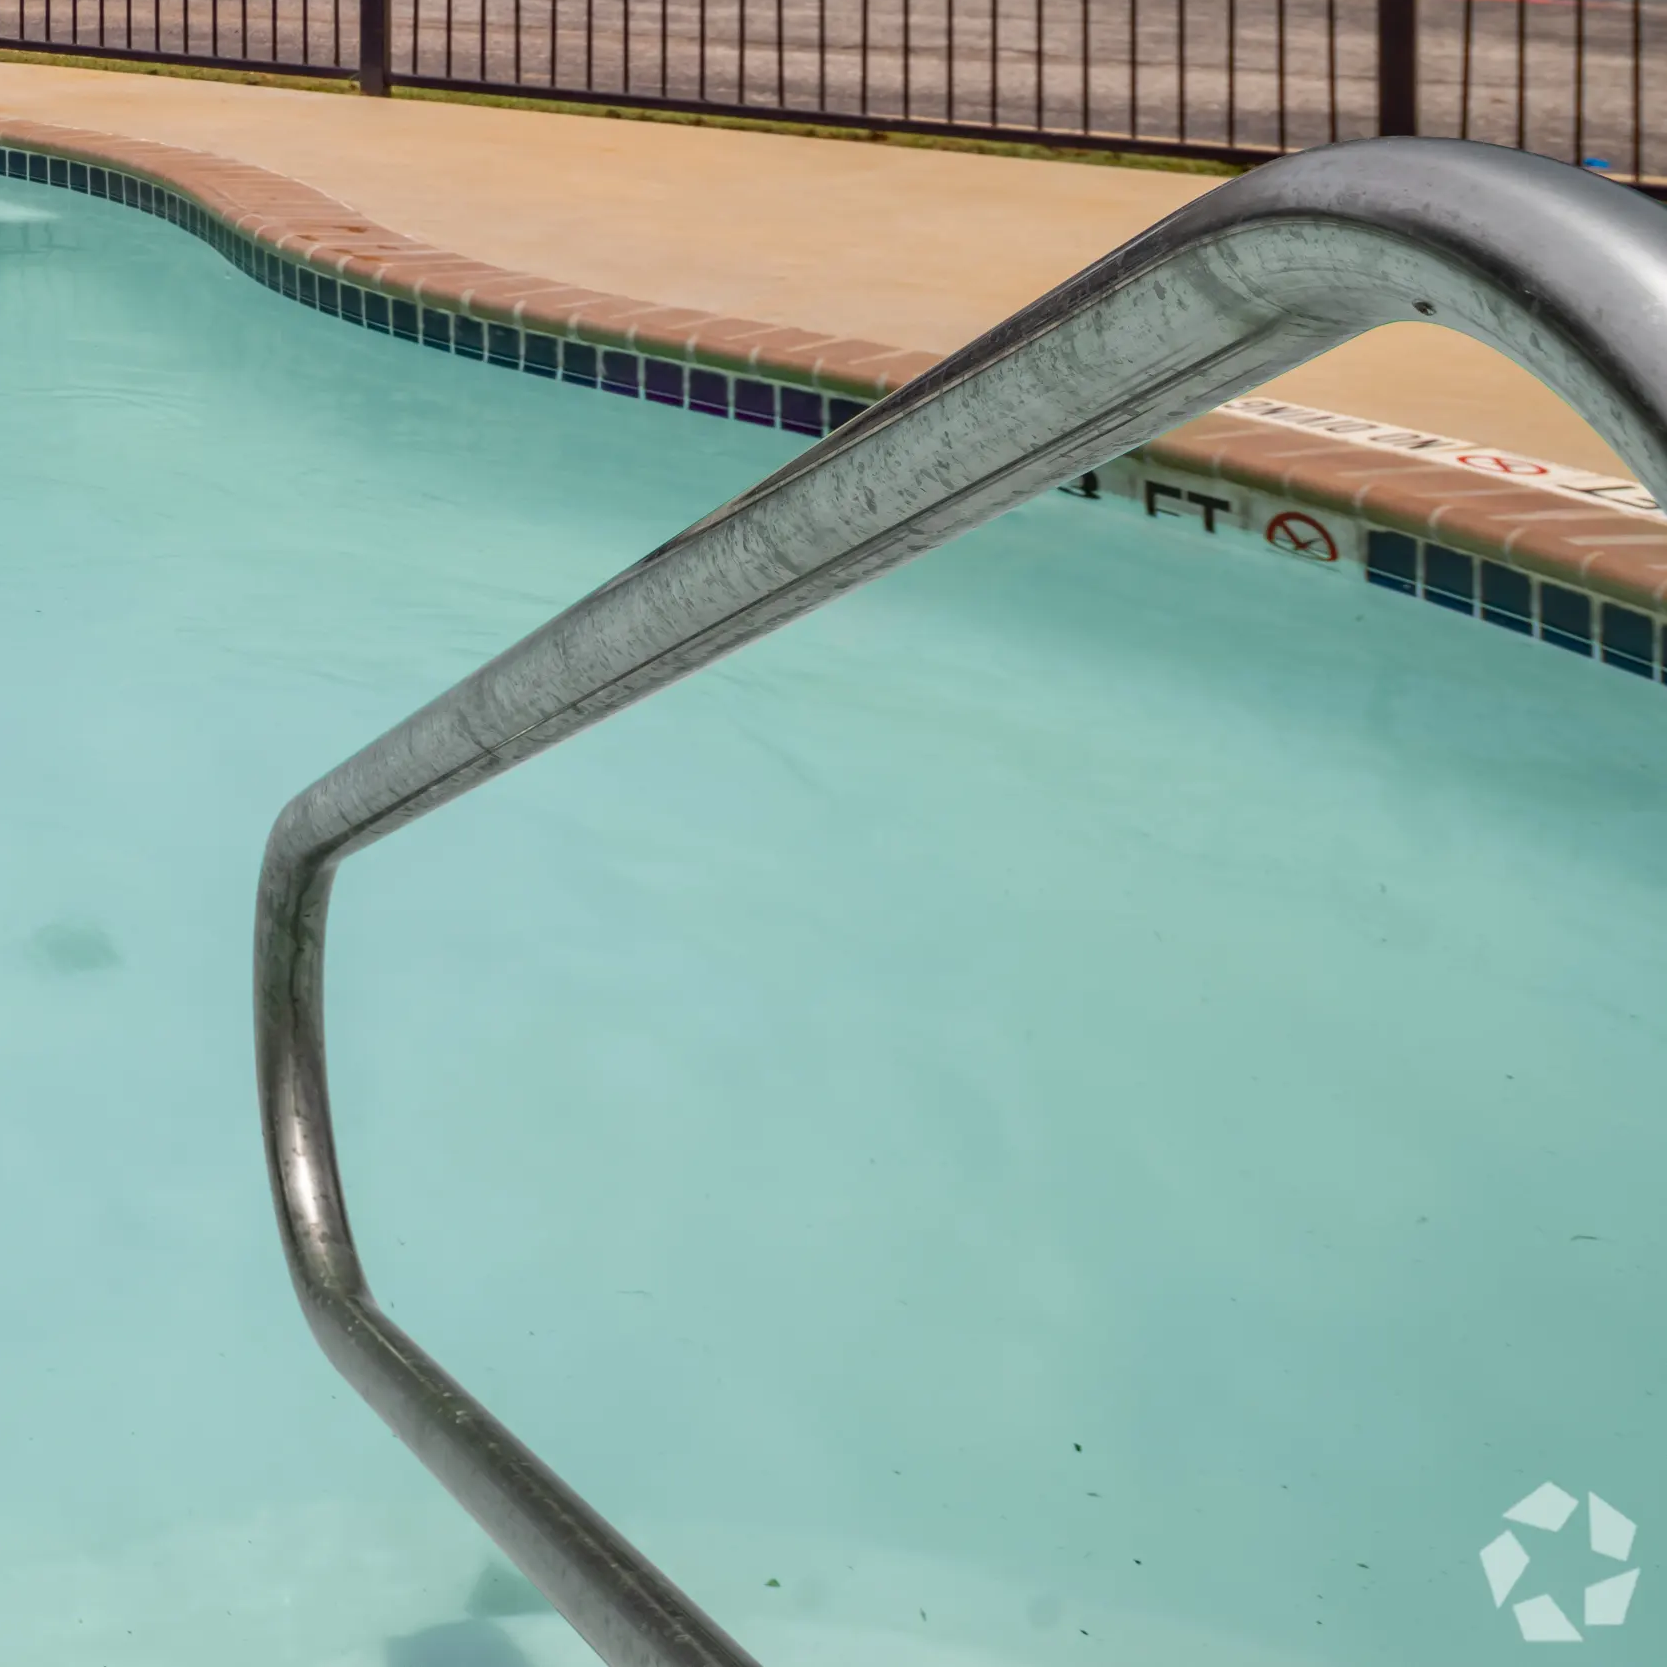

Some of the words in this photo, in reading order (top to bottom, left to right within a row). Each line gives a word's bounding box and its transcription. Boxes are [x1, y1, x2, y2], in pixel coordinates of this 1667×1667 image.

[1224, 400, 1378, 434] DIVING
[1369, 432, 1455, 450] NO
[1145, 480, 1231, 533] FT
